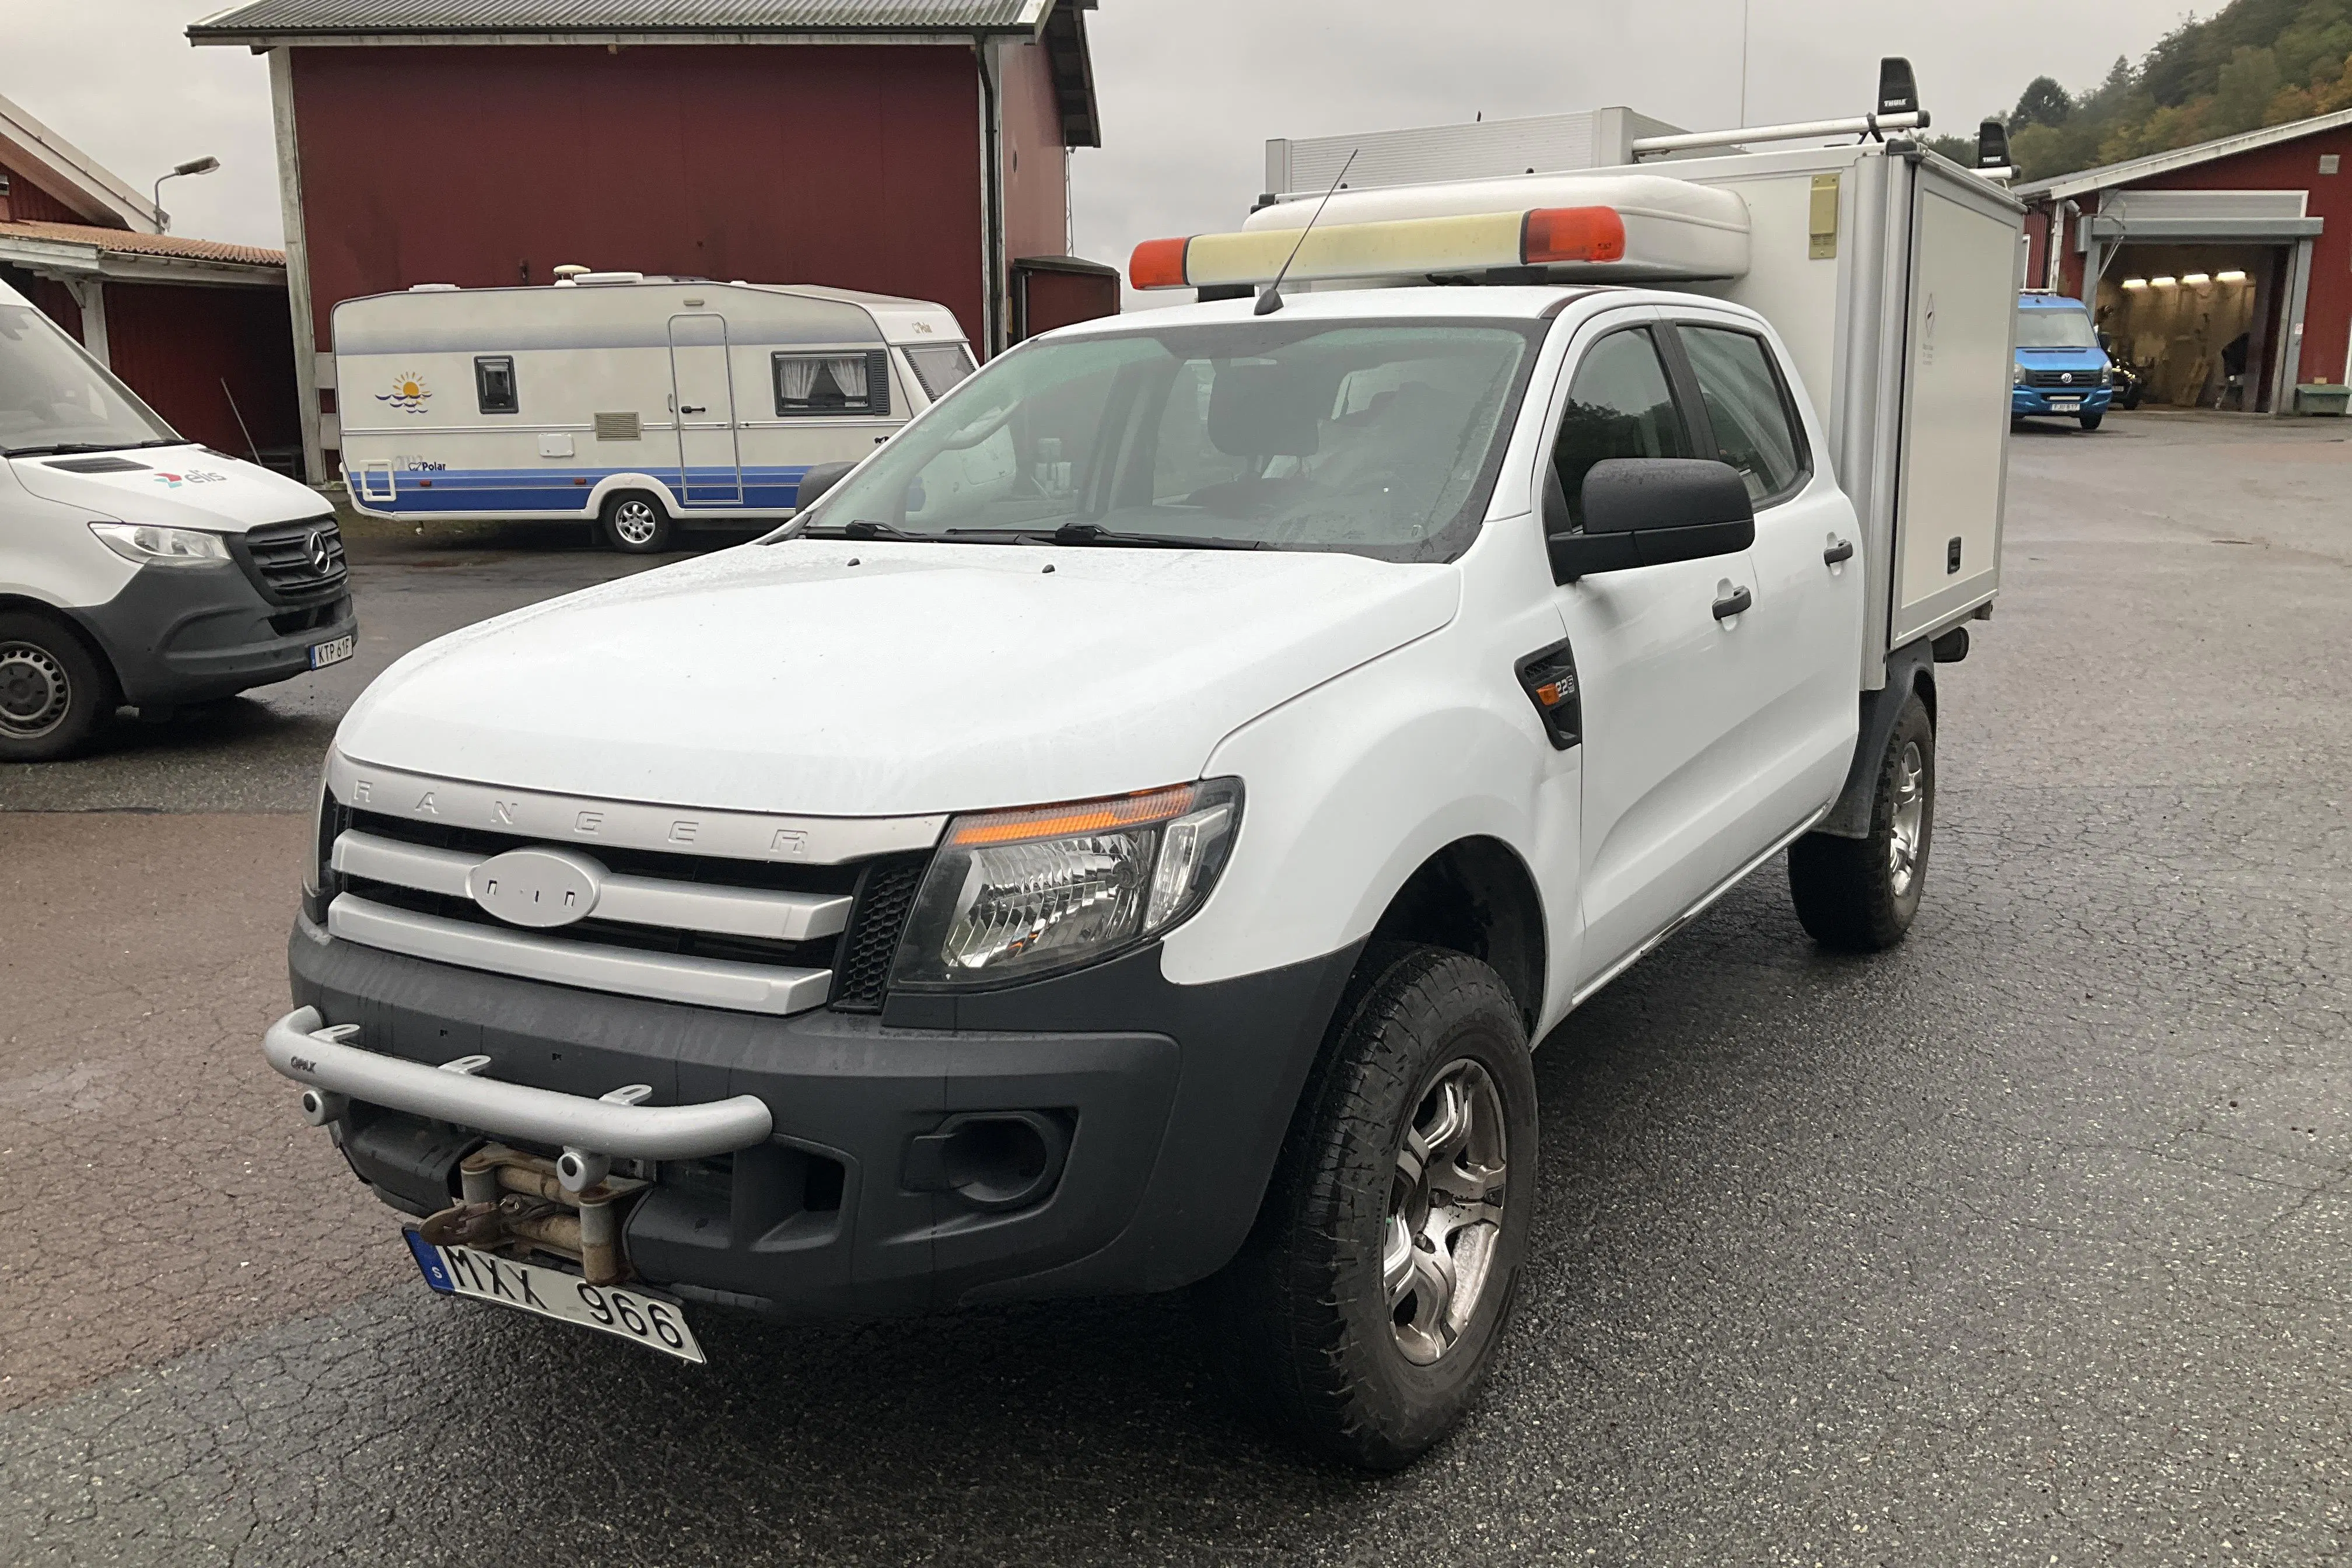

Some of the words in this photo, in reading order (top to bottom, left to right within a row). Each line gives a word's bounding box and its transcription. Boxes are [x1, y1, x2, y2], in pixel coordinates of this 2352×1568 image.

[1884, 99, 1906, 107] THULE
[421, 461, 446, 471] Polar
[184, 470, 227, 483] elis
[318, 643, 334, 664] KTP
[337, 638, 349, 657] 61F
[353, 780, 808, 854] RANGER
[432, 1266, 443, 1279] S
[576, 1283, 684, 1349] 966
